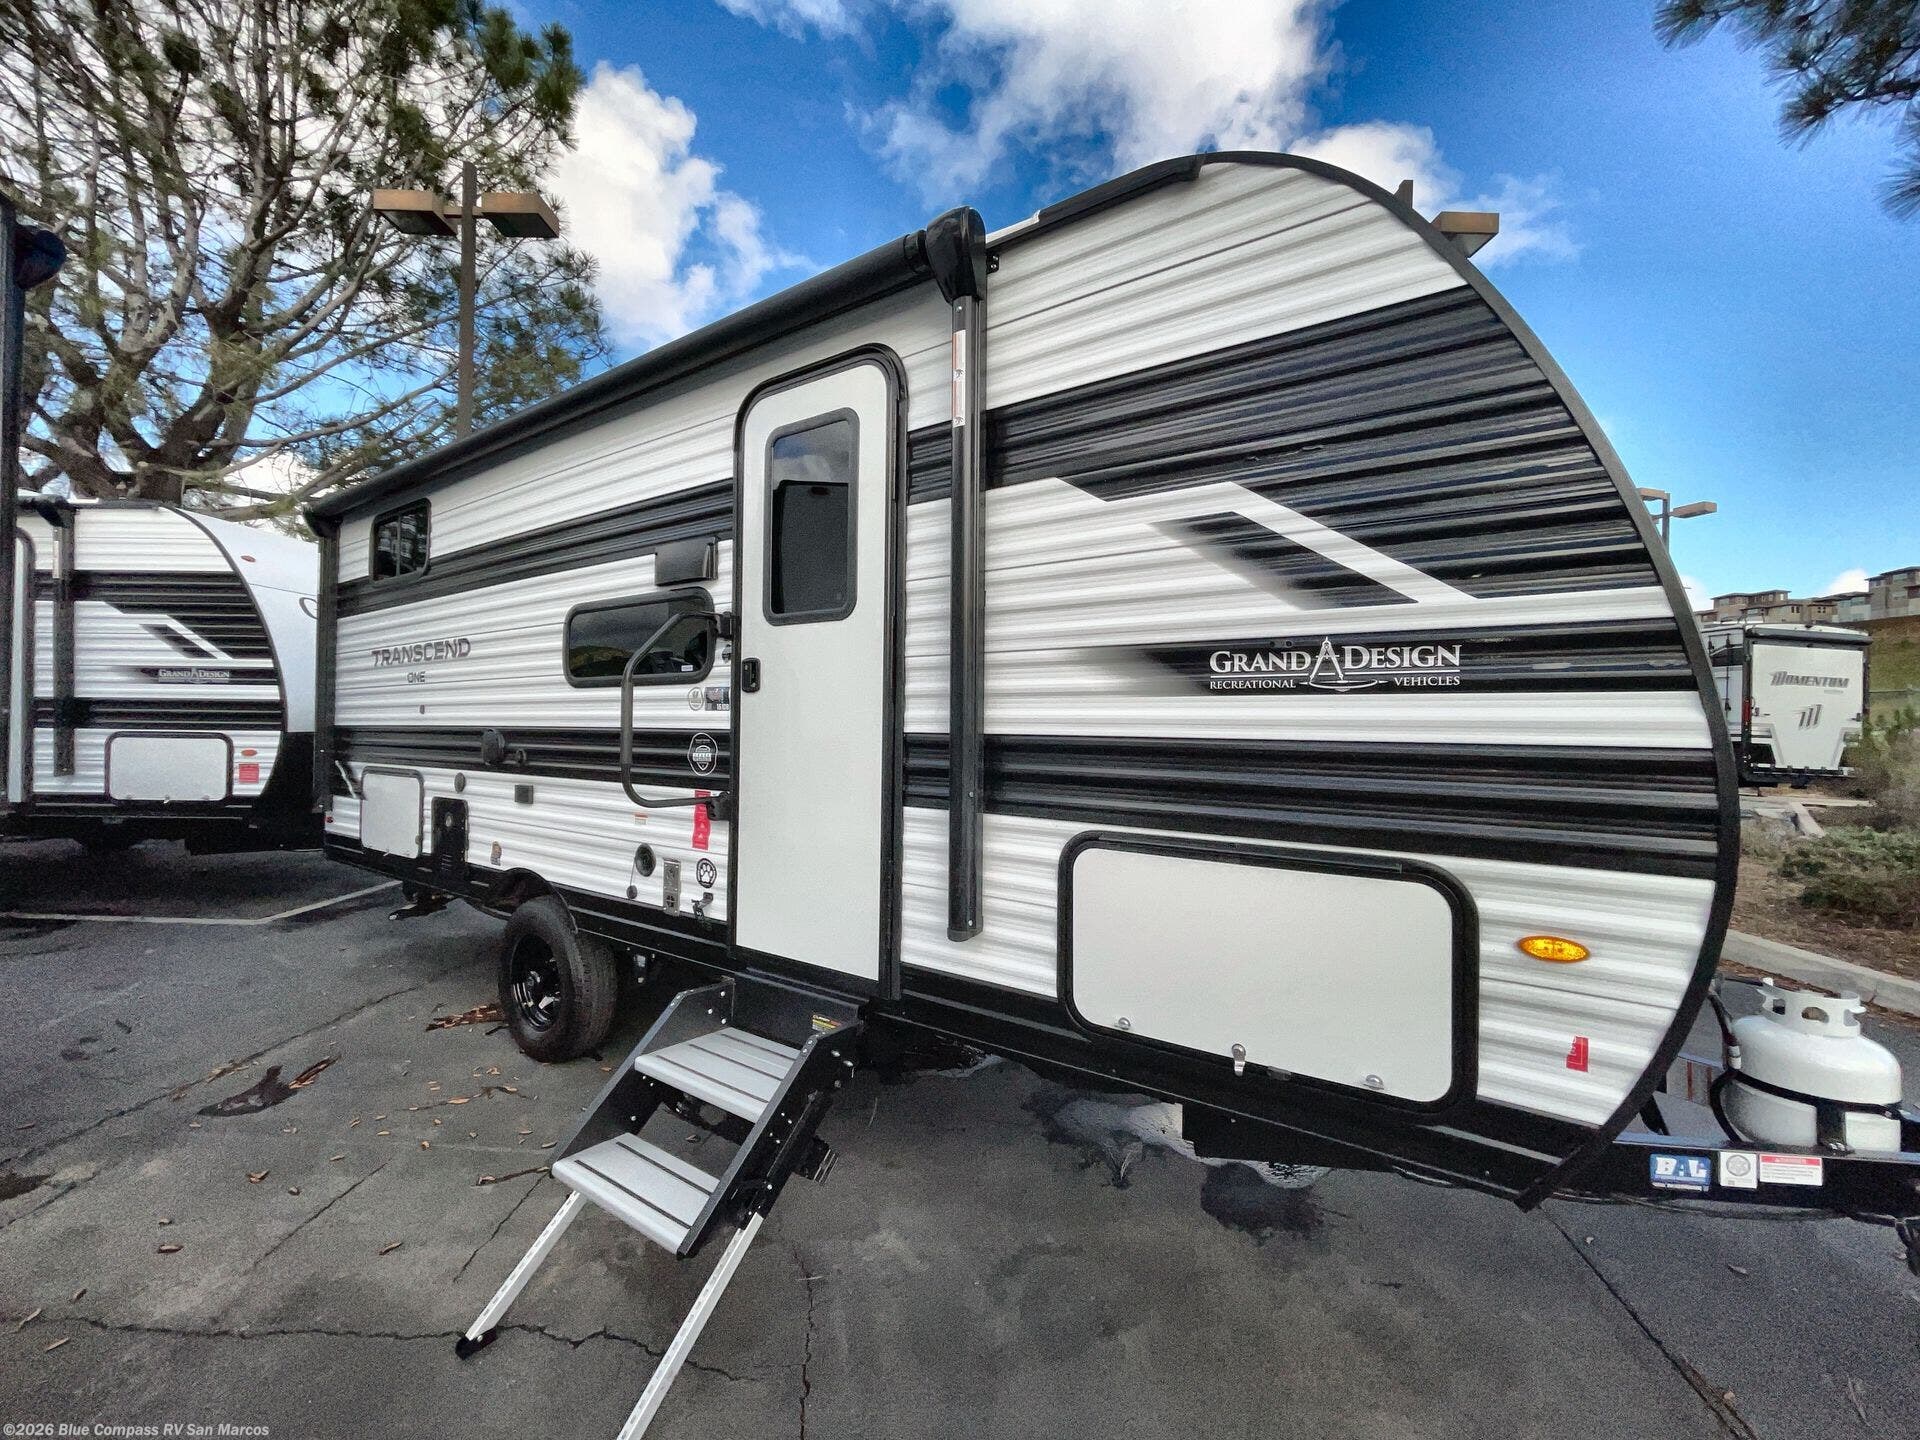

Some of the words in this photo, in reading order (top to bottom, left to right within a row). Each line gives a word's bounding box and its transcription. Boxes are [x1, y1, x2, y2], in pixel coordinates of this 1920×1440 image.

[371, 637, 471, 668] TRANSCEND
[1208, 650, 1311, 674] GRAND
[1342, 644, 1463, 670] DESIGN
[159, 668, 191, 678] GRAND
[199, 668, 230, 678] DESIGN
[406, 671, 426, 684] ONE
[1770, 671, 1850, 688] MOMENTUM
[1209, 678, 1297, 690] RECREATIONAL
[1393, 675, 1461, 687] VEHICLES
